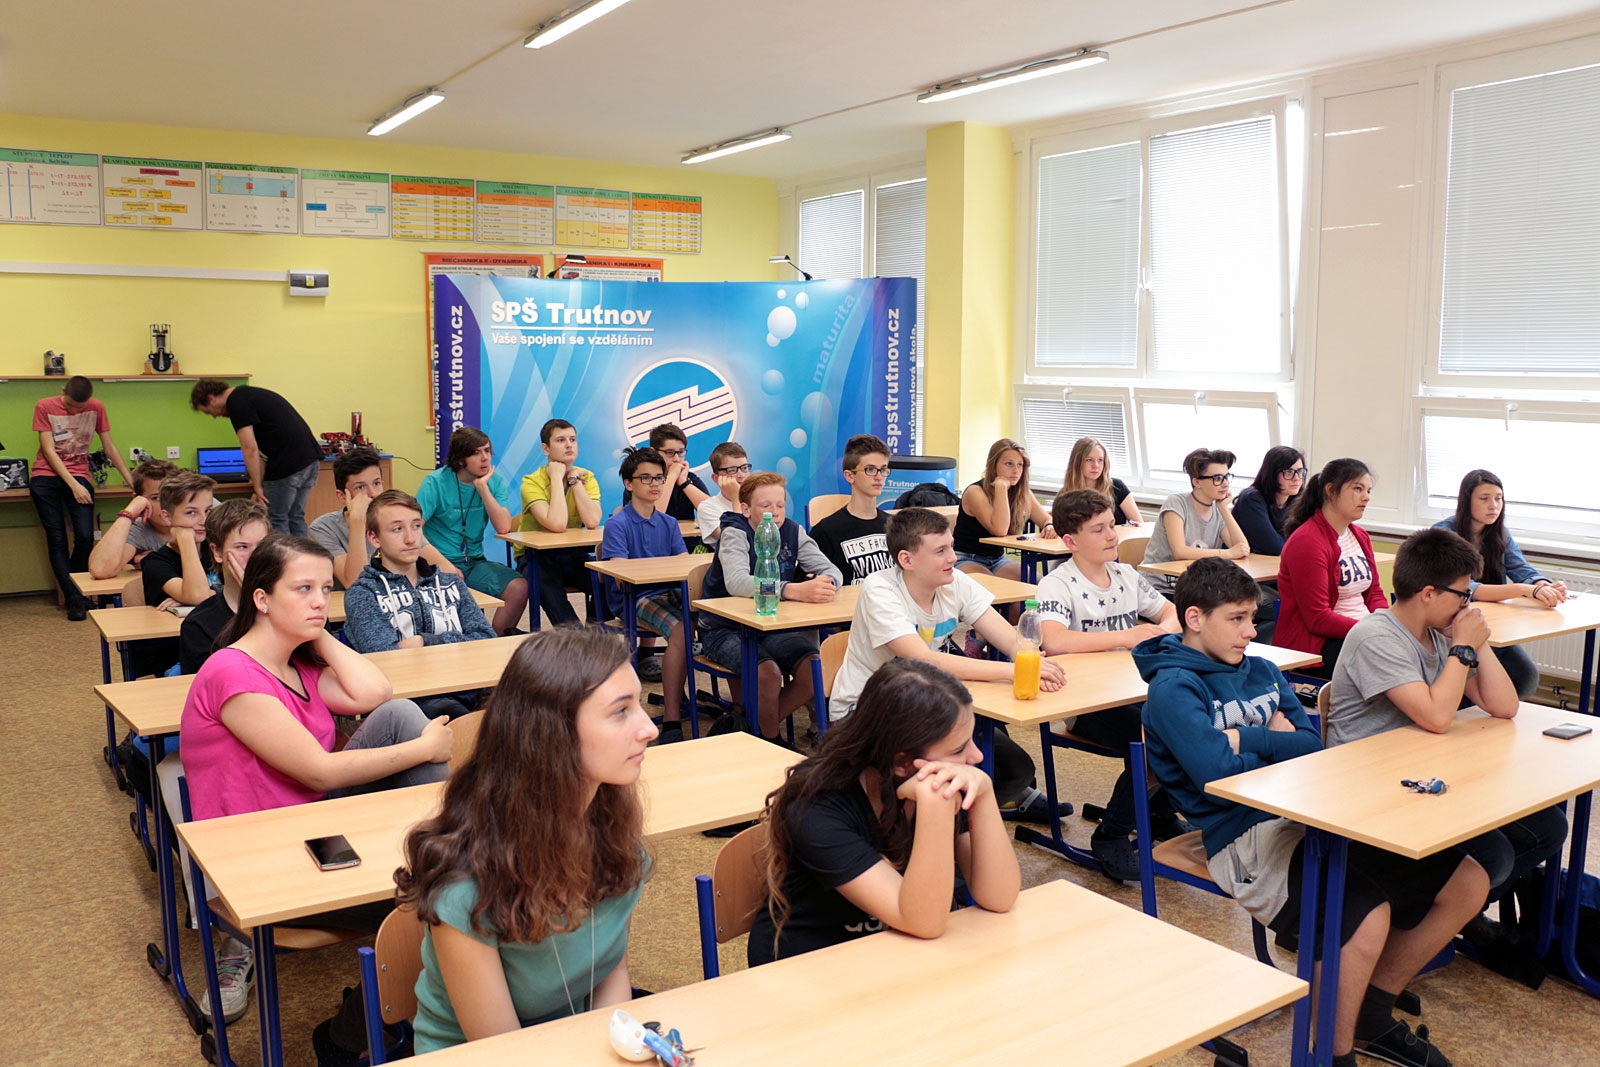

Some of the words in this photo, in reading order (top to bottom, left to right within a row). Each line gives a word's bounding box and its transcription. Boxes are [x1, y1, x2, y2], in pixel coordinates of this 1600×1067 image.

[491, 297, 539, 324] SPŠ
[546, 302, 653, 326] Trutnov
[491, 332, 517, 345] Vaše
[520, 333, 566, 347] spojení
[569, 334, 585, 345] se
[587, 333, 653, 346] vzděláním
[812, 294, 856, 385] maturita
[448, 305, 464, 432] pstrutnov.cz
[885, 308, 902, 455] .spstrutnov.cz
[846, 541, 866, 555] IT'S
